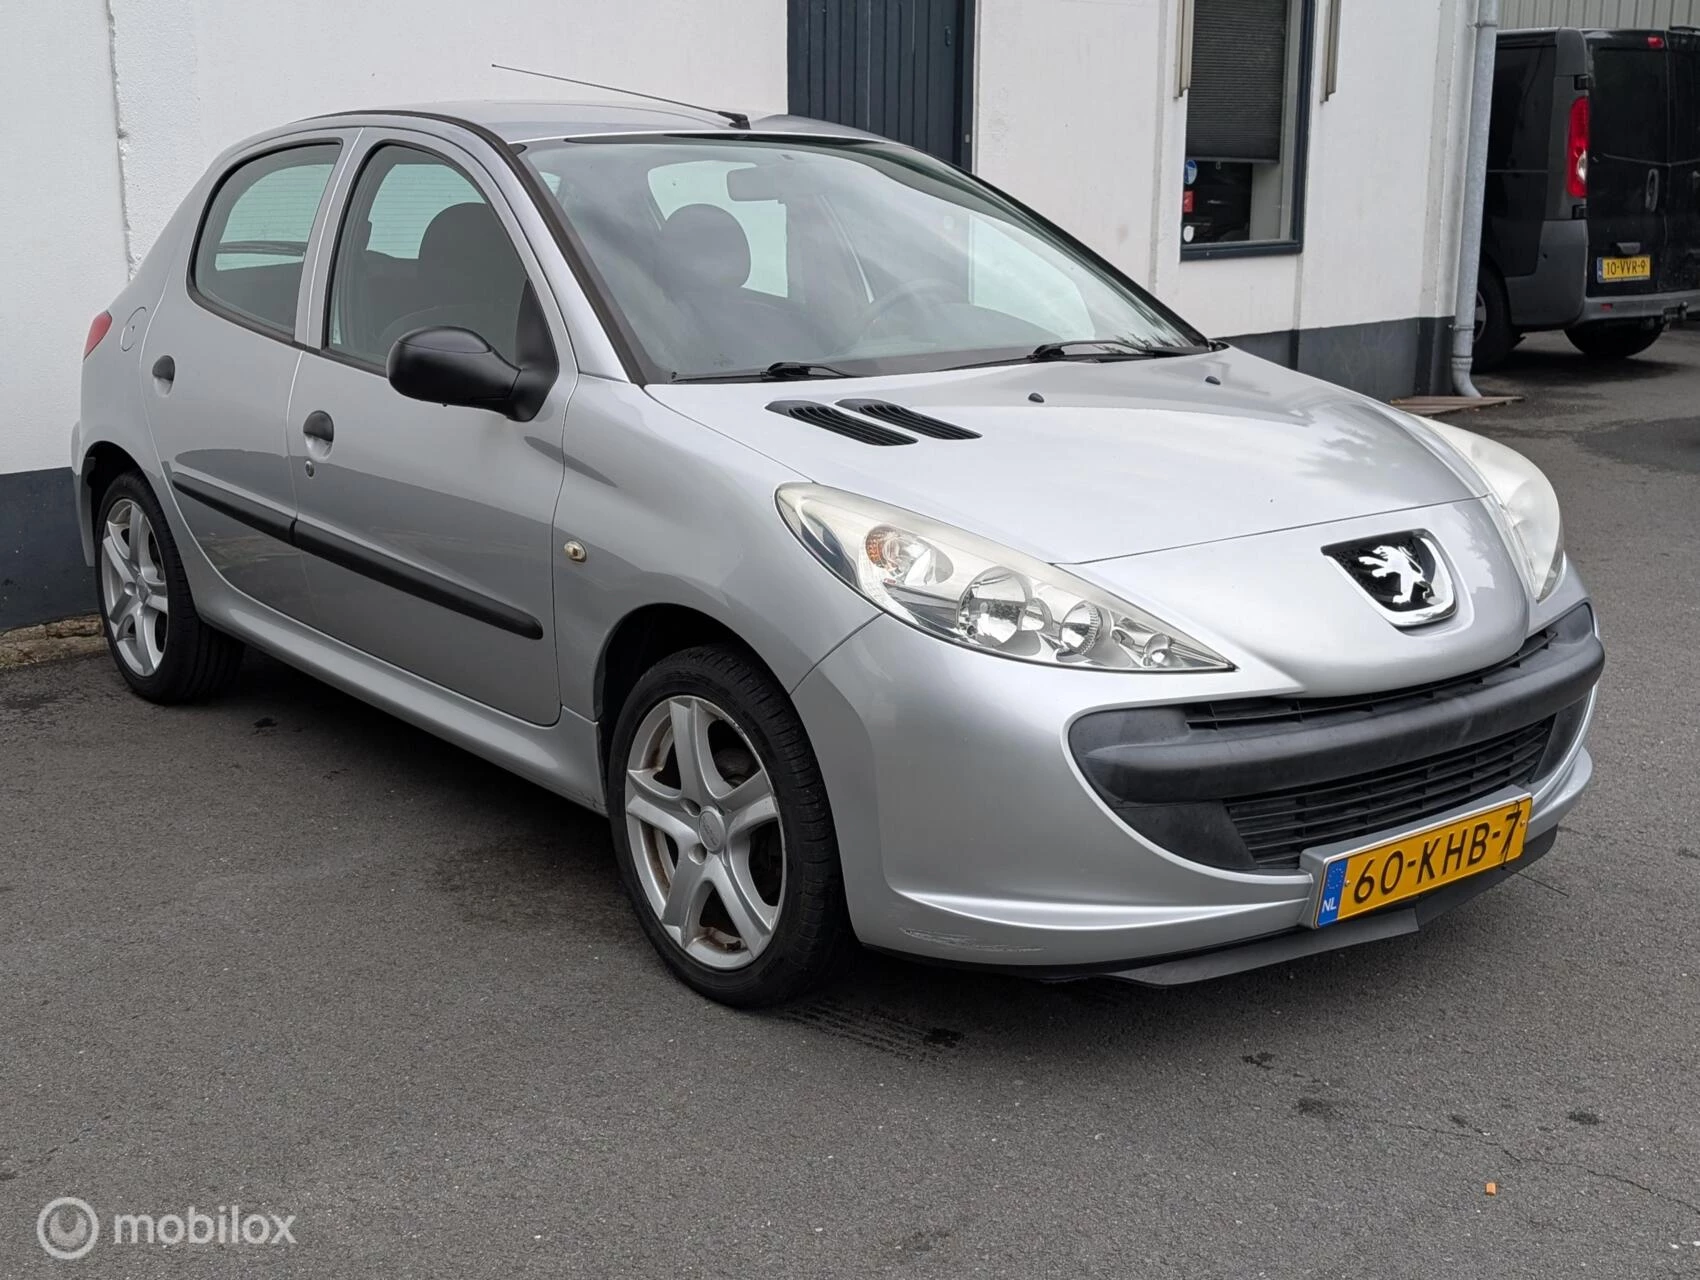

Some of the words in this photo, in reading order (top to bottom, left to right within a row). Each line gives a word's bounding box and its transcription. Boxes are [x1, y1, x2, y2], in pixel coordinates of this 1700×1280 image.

[1606, 260, 1646, 275] 10-VVR-9
[1353, 810, 1522, 904] 60-KHB-7
[1322, 897, 1337, 913] NL
